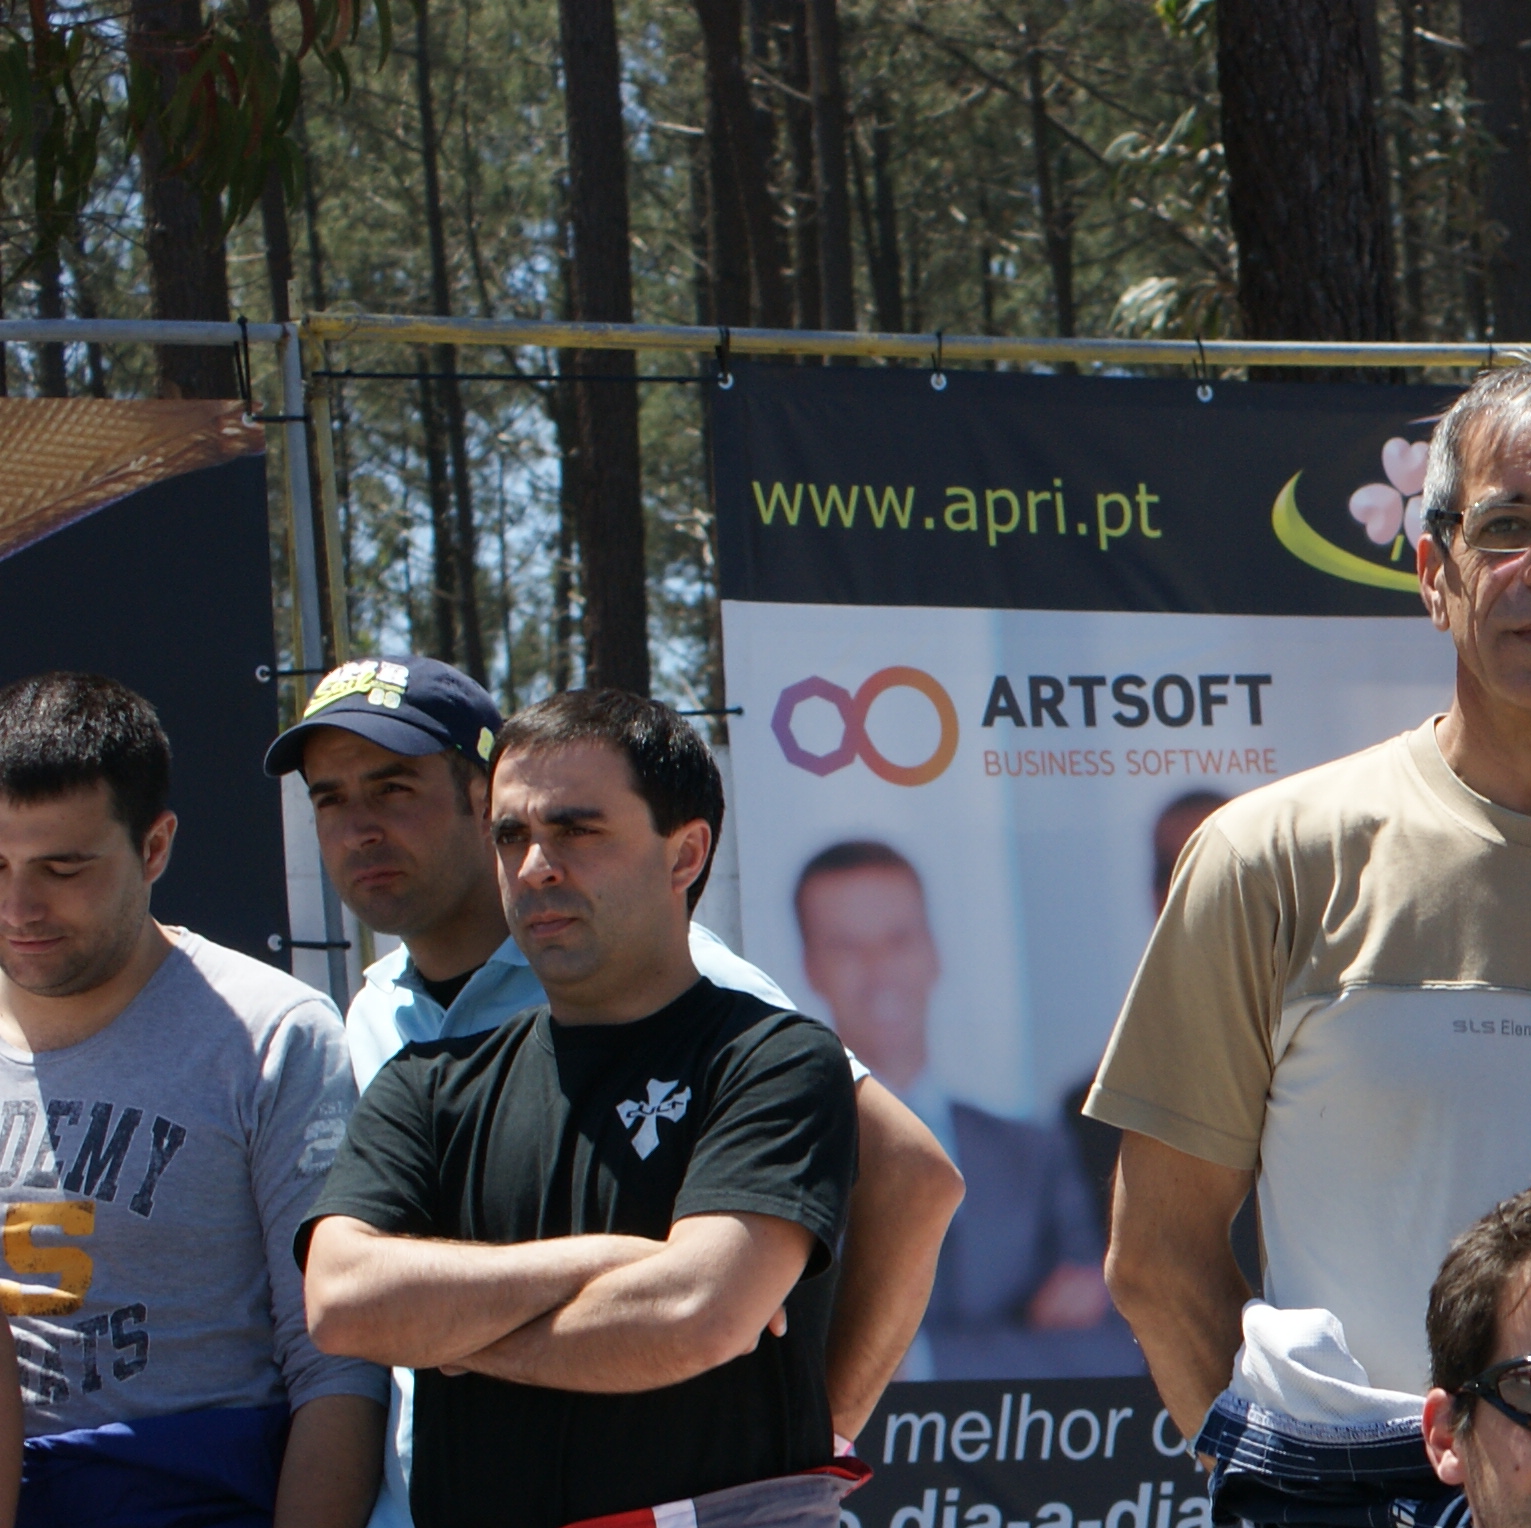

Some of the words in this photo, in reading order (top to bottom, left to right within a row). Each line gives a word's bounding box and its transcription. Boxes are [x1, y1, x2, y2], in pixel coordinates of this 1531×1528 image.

[753, 478, 1162, 550] www.apri.pt
[982, 673, 1273, 728] ARTSOFT
[984, 748, 1115, 777] BUSINESS
[1126, 748, 1278, 776] SOFTWARE
[1452, 1019, 1496, 1034] SLS
[883, 1393, 1132, 1464] melhor
